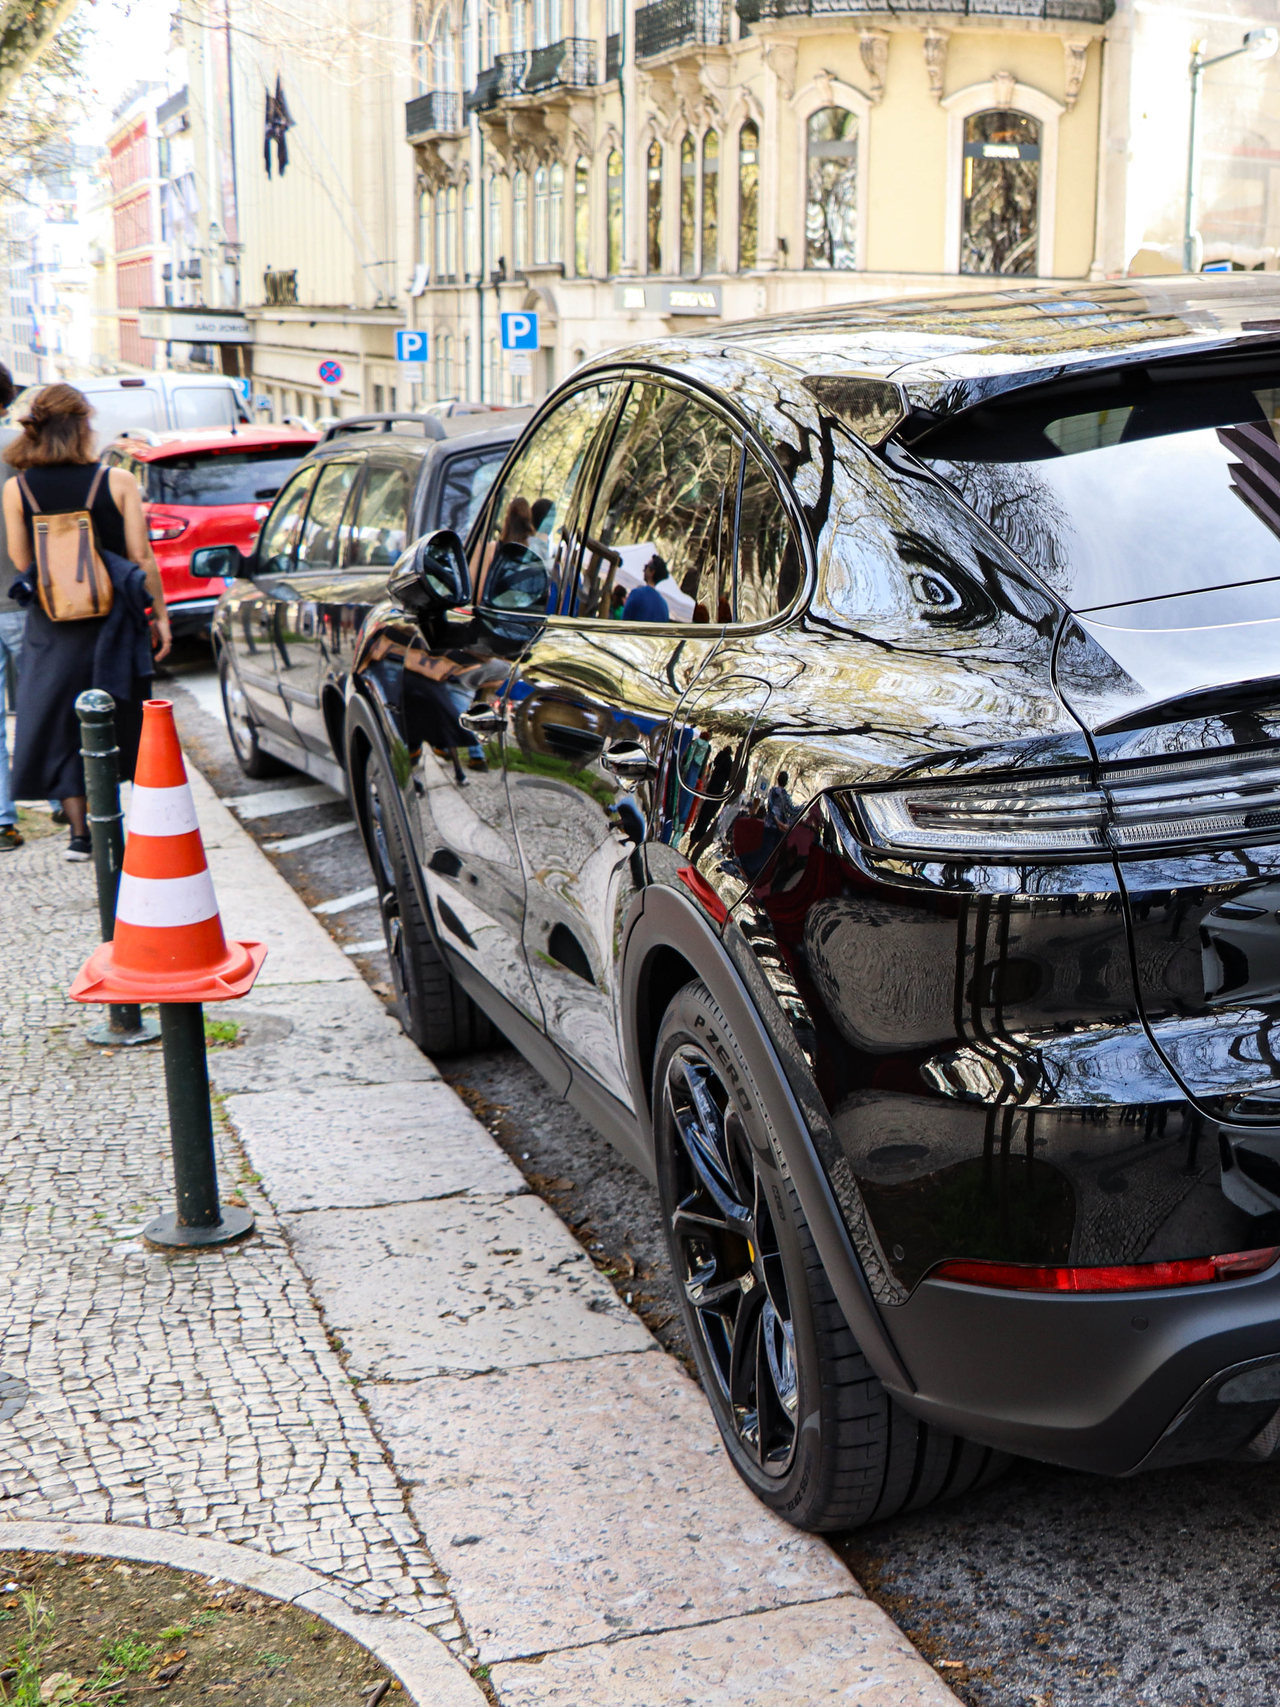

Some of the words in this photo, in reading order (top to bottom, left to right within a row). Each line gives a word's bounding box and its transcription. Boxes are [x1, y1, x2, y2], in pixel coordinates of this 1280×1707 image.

[402, 333, 423, 360] P
[507, 315, 531, 348] P
[694, 1015, 706, 1028] P
[706, 1028, 752, 1112] ZERO
